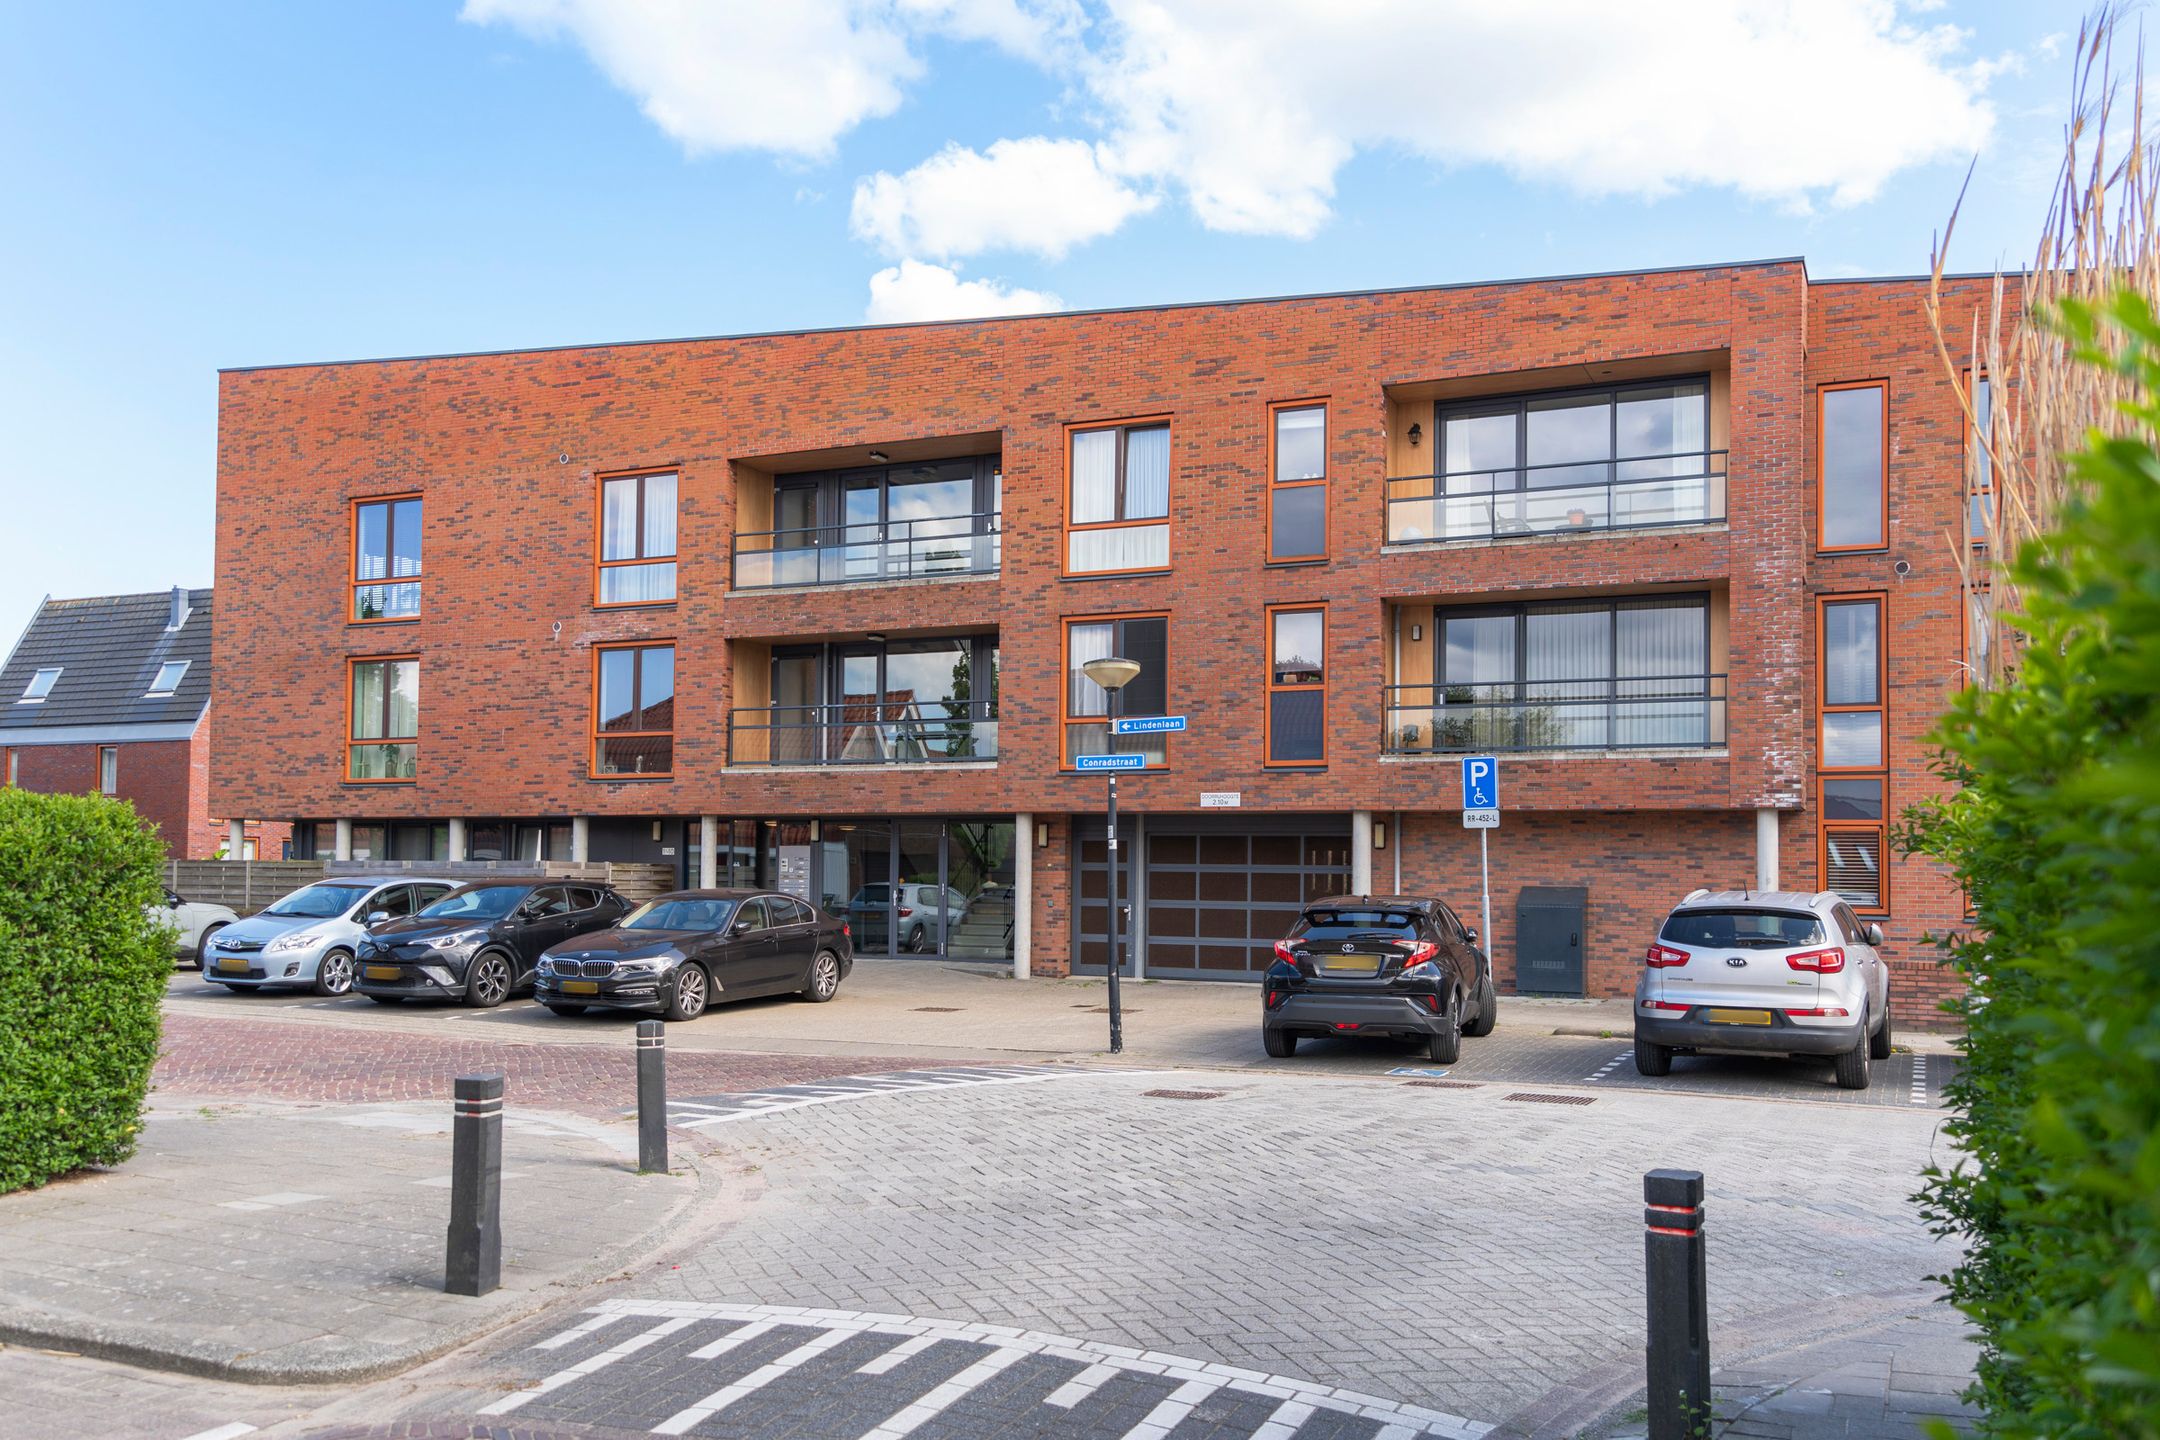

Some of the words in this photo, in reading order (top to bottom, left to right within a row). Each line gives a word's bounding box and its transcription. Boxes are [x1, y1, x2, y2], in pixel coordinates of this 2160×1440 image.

[1134, 721, 1180, 730] Lindenlaan
[1083, 758, 1138, 767] Conradstraat
[1471, 761, 1489, 787] P
[1467, 814, 1497, 822] RR-452-L
